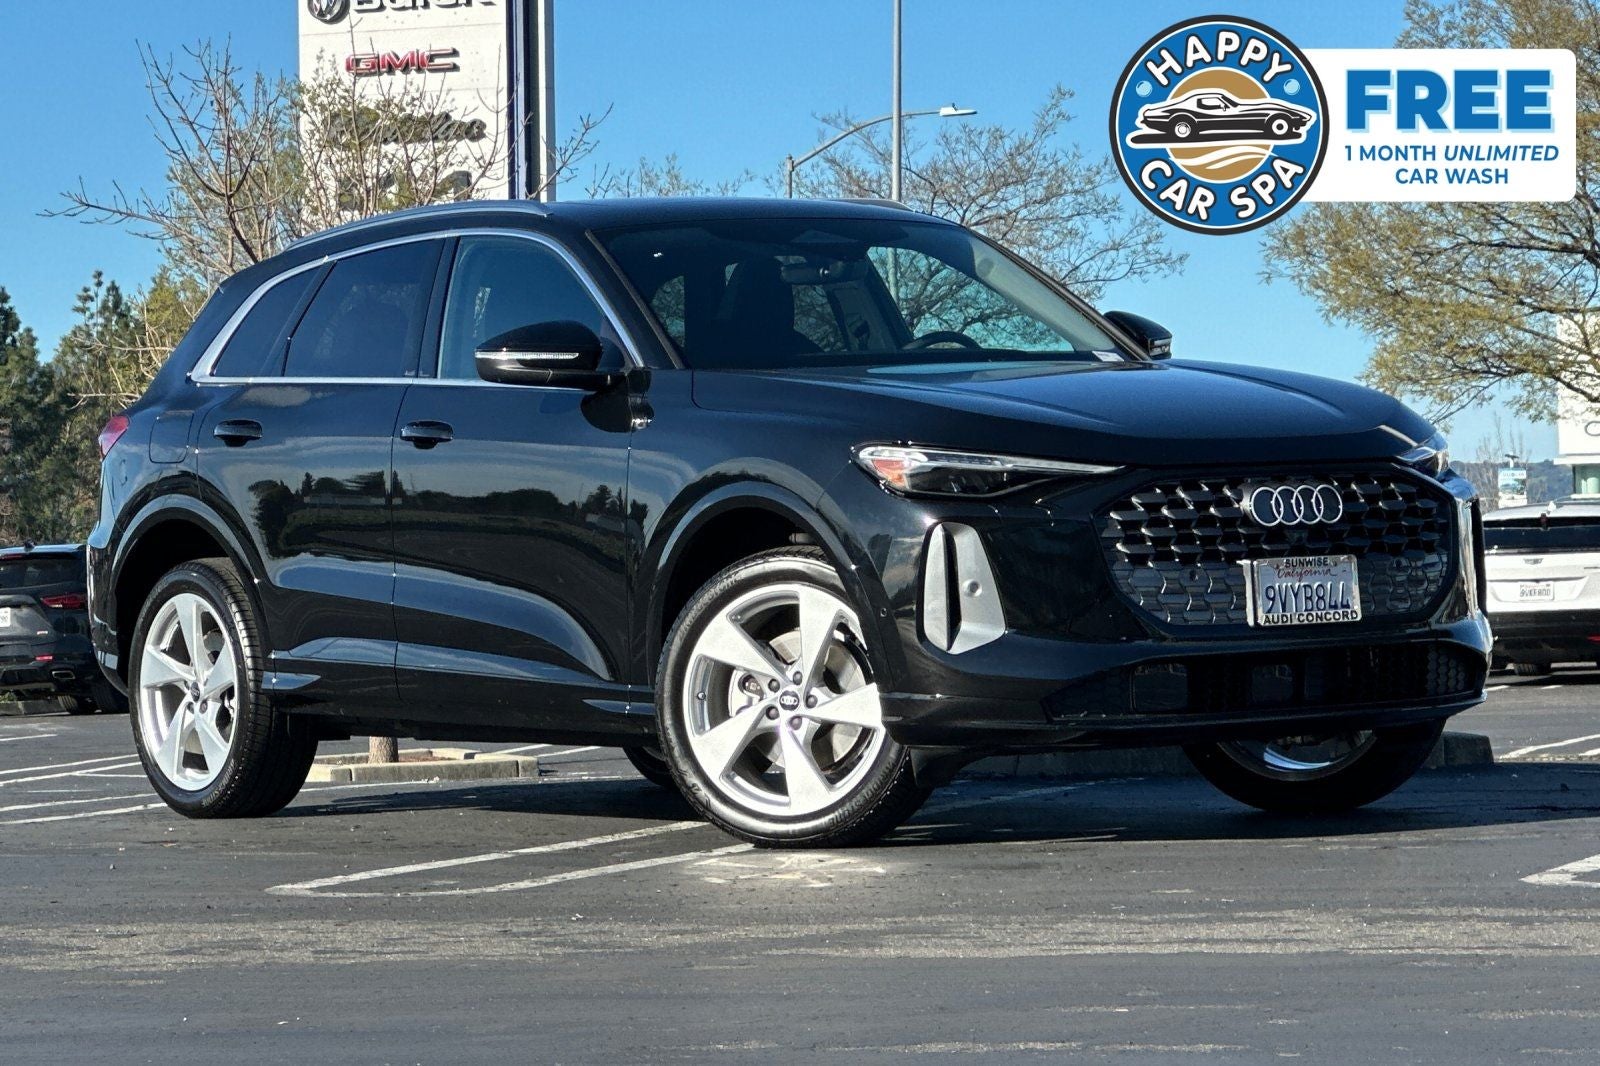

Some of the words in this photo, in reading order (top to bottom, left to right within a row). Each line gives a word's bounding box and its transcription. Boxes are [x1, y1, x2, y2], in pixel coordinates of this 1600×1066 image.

[345, 47, 459, 76] GMC
[1285, 557, 1329, 568] SUNWISE
[1277, 568, 1337, 582] California
[1265, 581, 1350, 614] 9VYB844
[1263, 613, 1293, 625] AUDI
[1297, 610, 1358, 623] CONCORD
